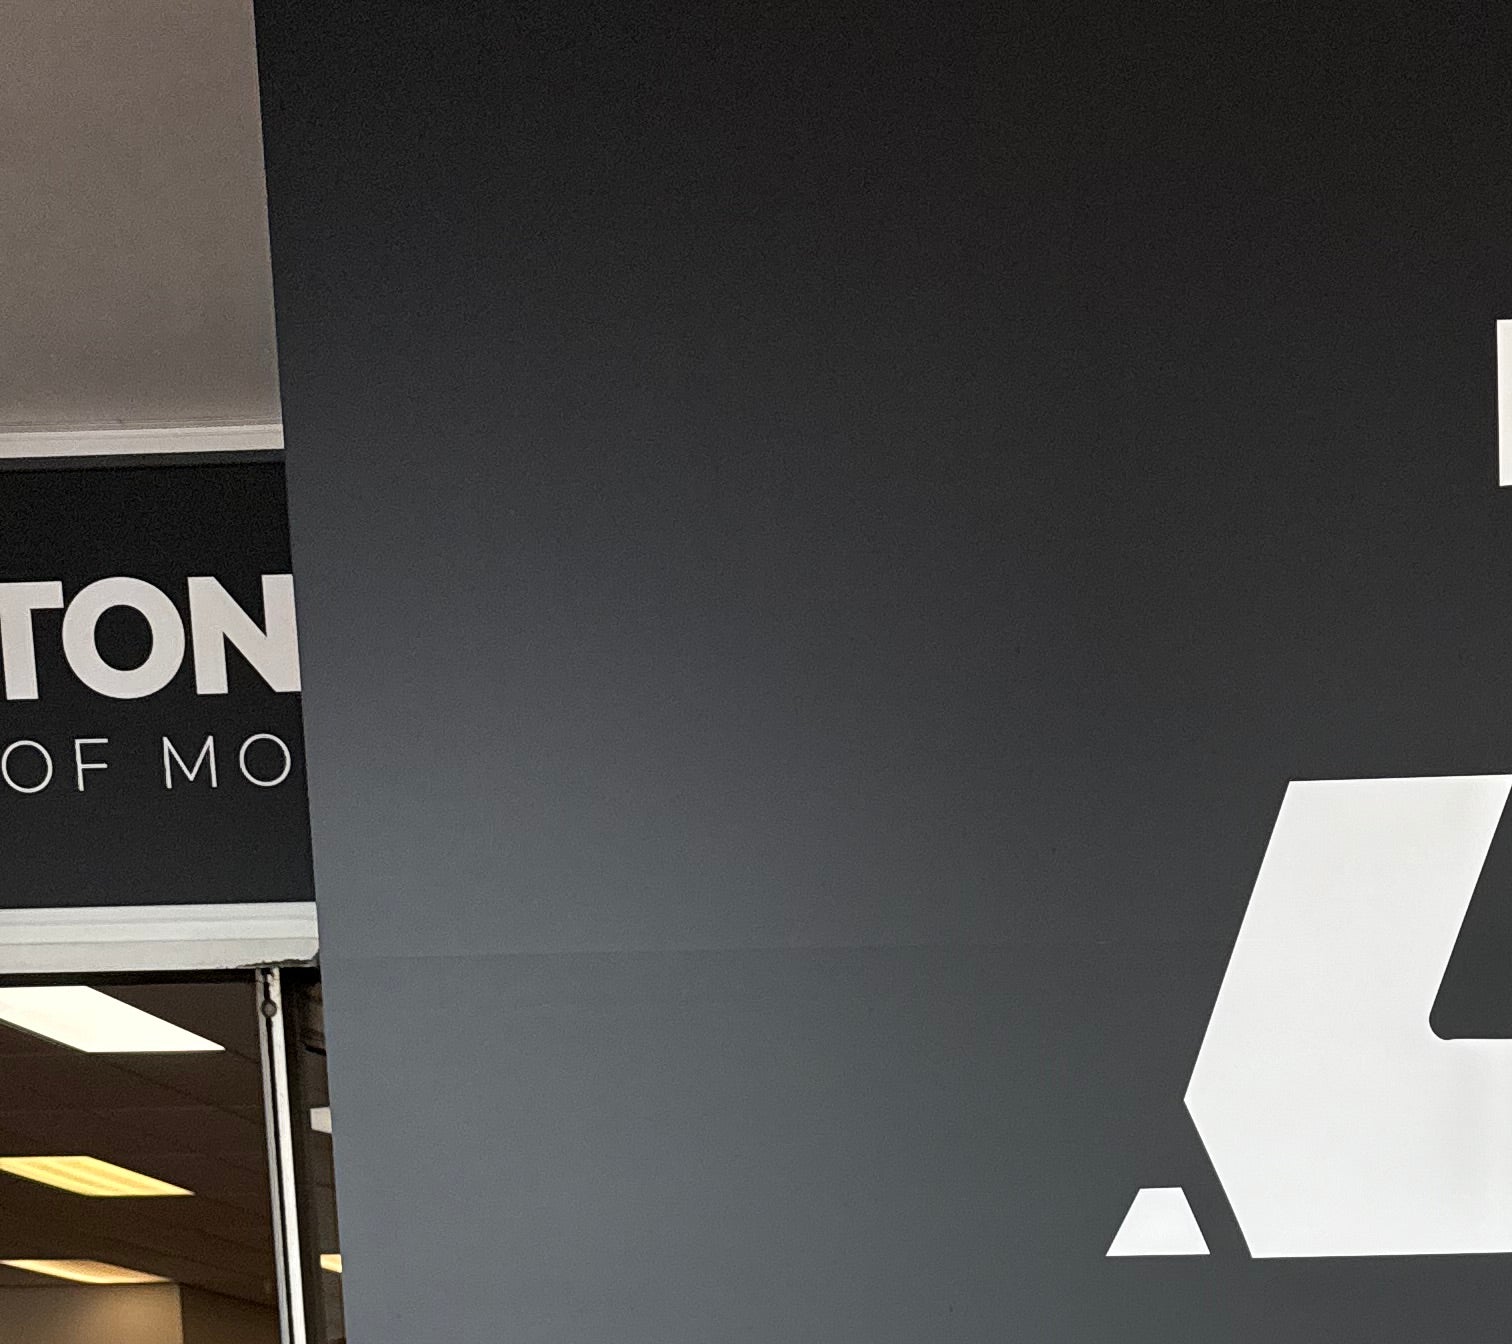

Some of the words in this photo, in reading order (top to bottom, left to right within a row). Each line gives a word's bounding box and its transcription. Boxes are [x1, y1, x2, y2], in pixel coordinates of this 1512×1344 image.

[0, 573, 301, 699] TON
[1, 738, 109, 793] OF
[163, 733, 291, 789] MO
